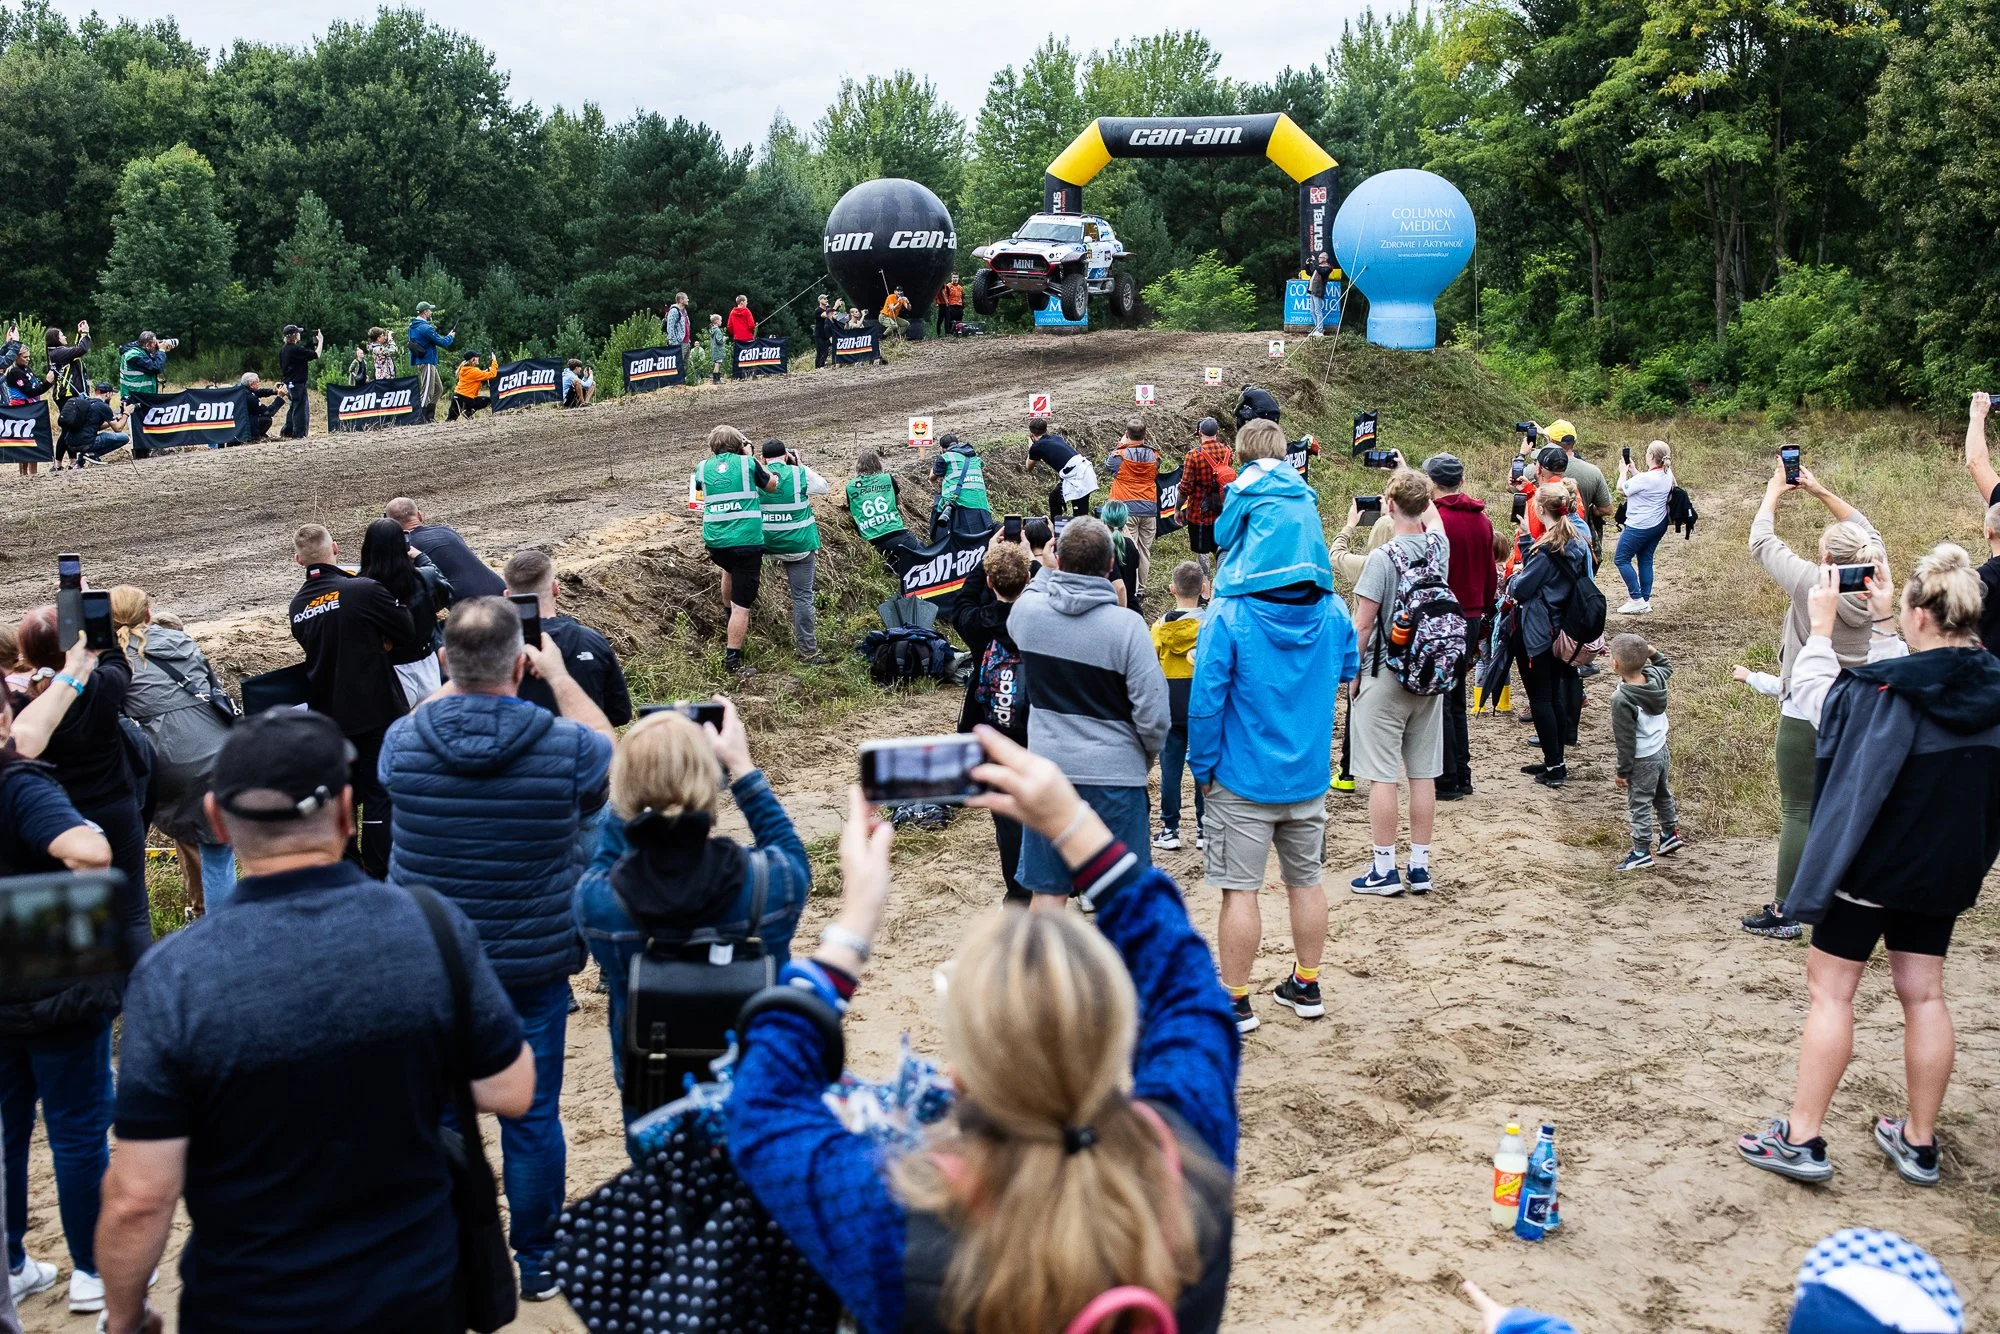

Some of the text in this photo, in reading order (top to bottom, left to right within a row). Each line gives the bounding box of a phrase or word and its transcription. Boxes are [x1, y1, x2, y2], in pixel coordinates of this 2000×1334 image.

[1129, 127, 1243, 146] can-am
[1391, 207, 1456, 219] COLUMNA
[1313, 205, 1325, 252] Taurus
[1399, 220, 1451, 231] MEDICA
[1013, 259, 1034, 269] MINI
[836, 335, 872, 349] can-am
[738, 346, 781, 361] can-am
[630, 355, 677, 375] can-am
[498, 368, 555, 392] can-am
[339, 388, 411, 412] can-am
[143, 401, 235, 425] can-am
[709, 501, 742, 513] MEDIA
[862, 496, 889, 517] 66
[762, 513, 793, 522] MEDIA
[860, 512, 898, 530] MEDIA
[293, 600, 340, 623] 4XDRIVE
